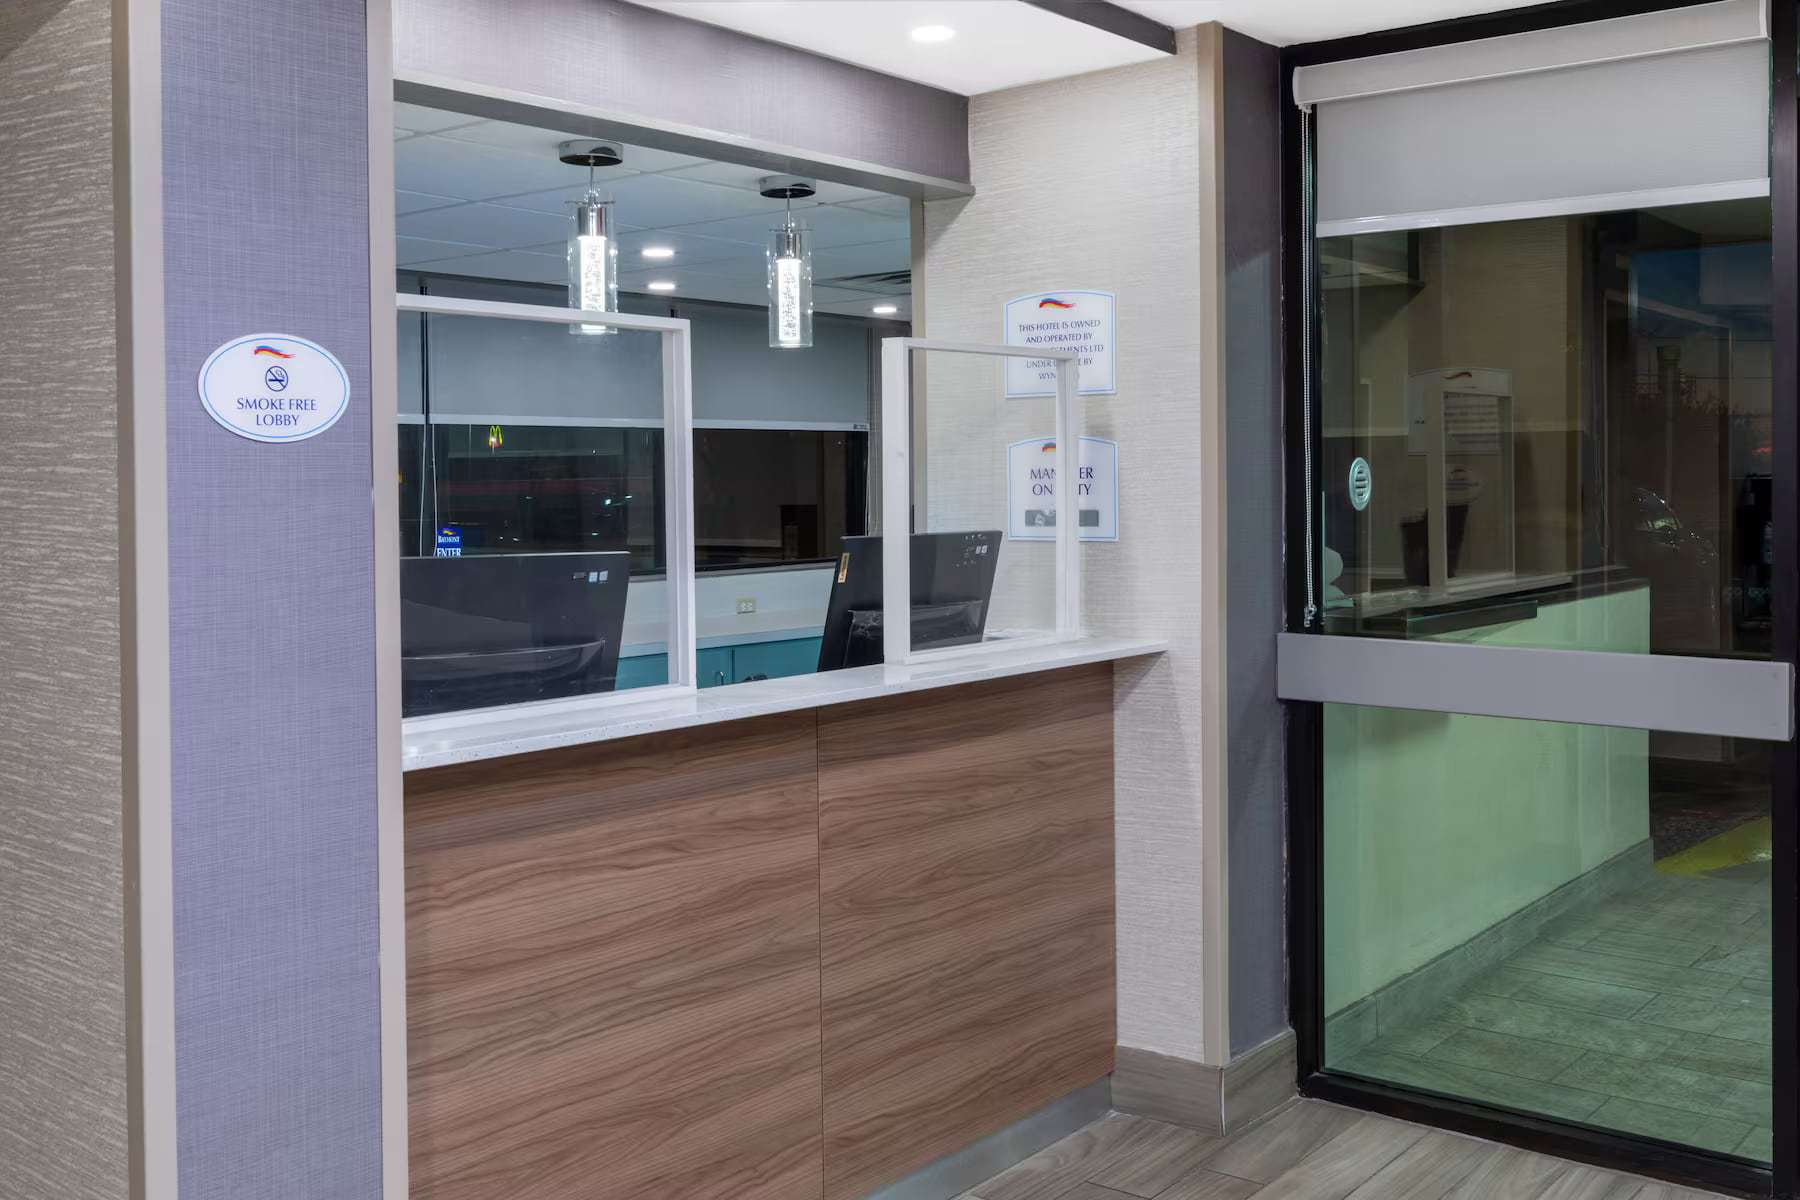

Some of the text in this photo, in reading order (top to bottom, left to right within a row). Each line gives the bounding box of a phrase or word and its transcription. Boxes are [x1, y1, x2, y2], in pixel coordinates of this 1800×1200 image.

[1019, 319, 1101, 333] THIS HOTEL IS OWNED
[1025, 332, 1093, 344] AND OPERATED BY
[1089, 344, 1104, 352] LTD
[1026, 359, 1052, 369] UNDER
[1083, 357, 1093, 366] BY
[236, 397, 318, 411] SMOKE FREE
[256, 414, 300, 426] LOBBY
[1030, 467, 1094, 480] MANER
[1032, 483, 1053, 496] ON
[436, 547, 462, 558] ENTER
